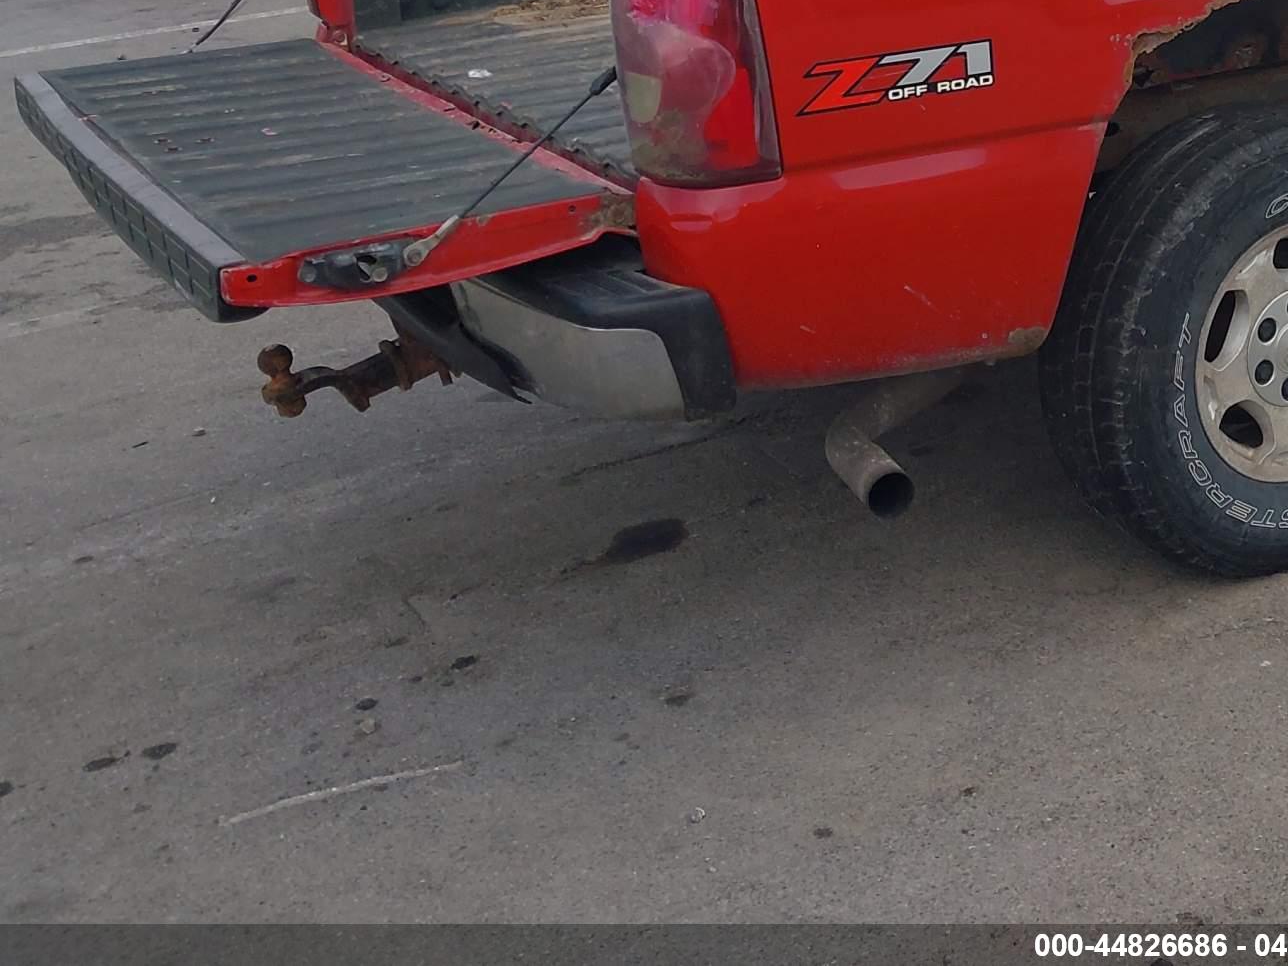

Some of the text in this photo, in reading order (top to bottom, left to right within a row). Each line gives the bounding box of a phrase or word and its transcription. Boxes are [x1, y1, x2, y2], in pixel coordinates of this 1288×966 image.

[796, 39, 993, 117] Z71
[888, 73, 994, 101] OFF ROAD
